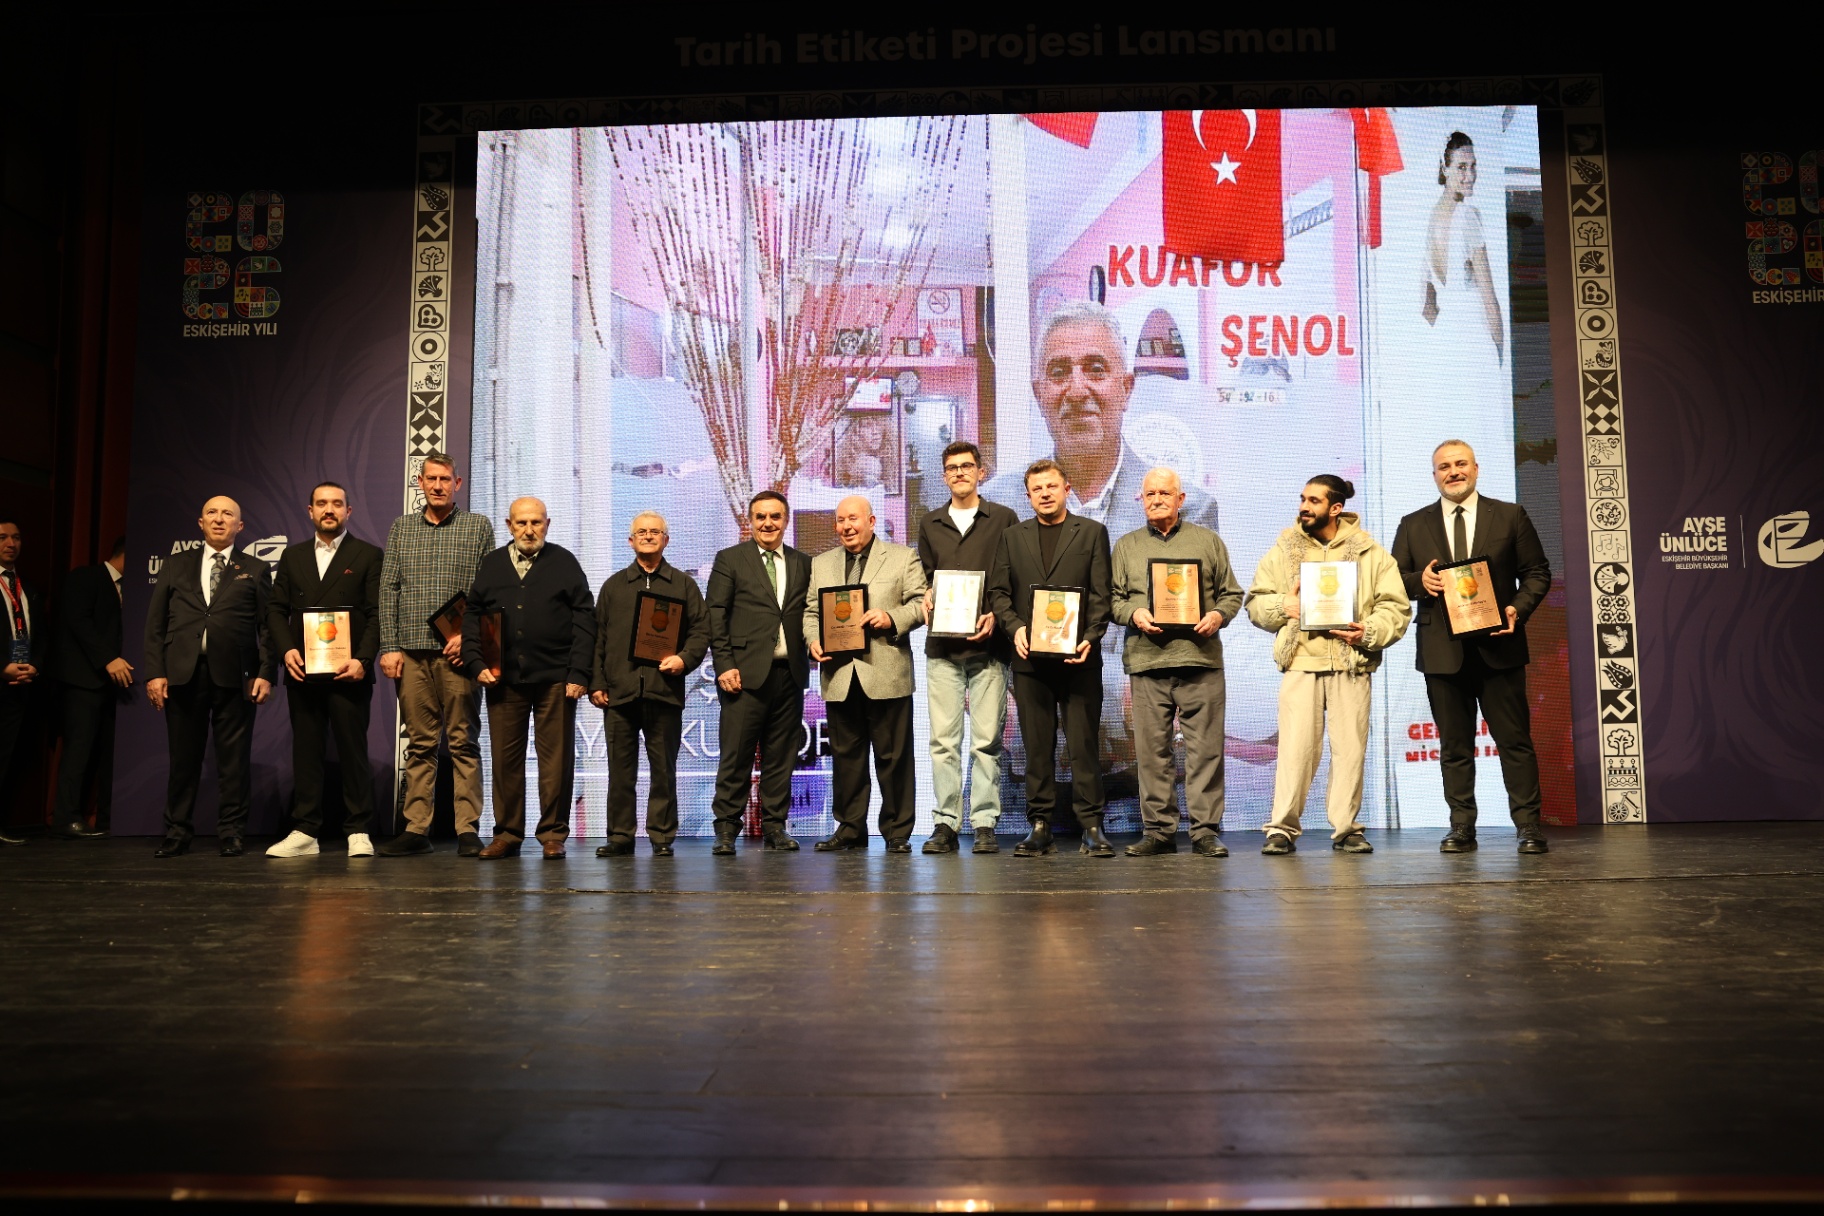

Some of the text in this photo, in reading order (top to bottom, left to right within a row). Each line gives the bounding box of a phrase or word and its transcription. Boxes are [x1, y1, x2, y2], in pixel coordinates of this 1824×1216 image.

[674, 23, 1337, 68] Tarih Etiketi Projesi Lansmanı
[183, 321, 278, 339] ESKİŞEHİR YILI
[1220, 314, 1355, 368] ŞENOL
[1682, 516, 1726, 535] AYŞE
[1659, 532, 1728, 553] ÜNLÜCE
[1675, 562, 1729, 570] BELEDİYE BAŞKANI
[1691, 554, 1728, 562] BÜYÜKŞEHİR
